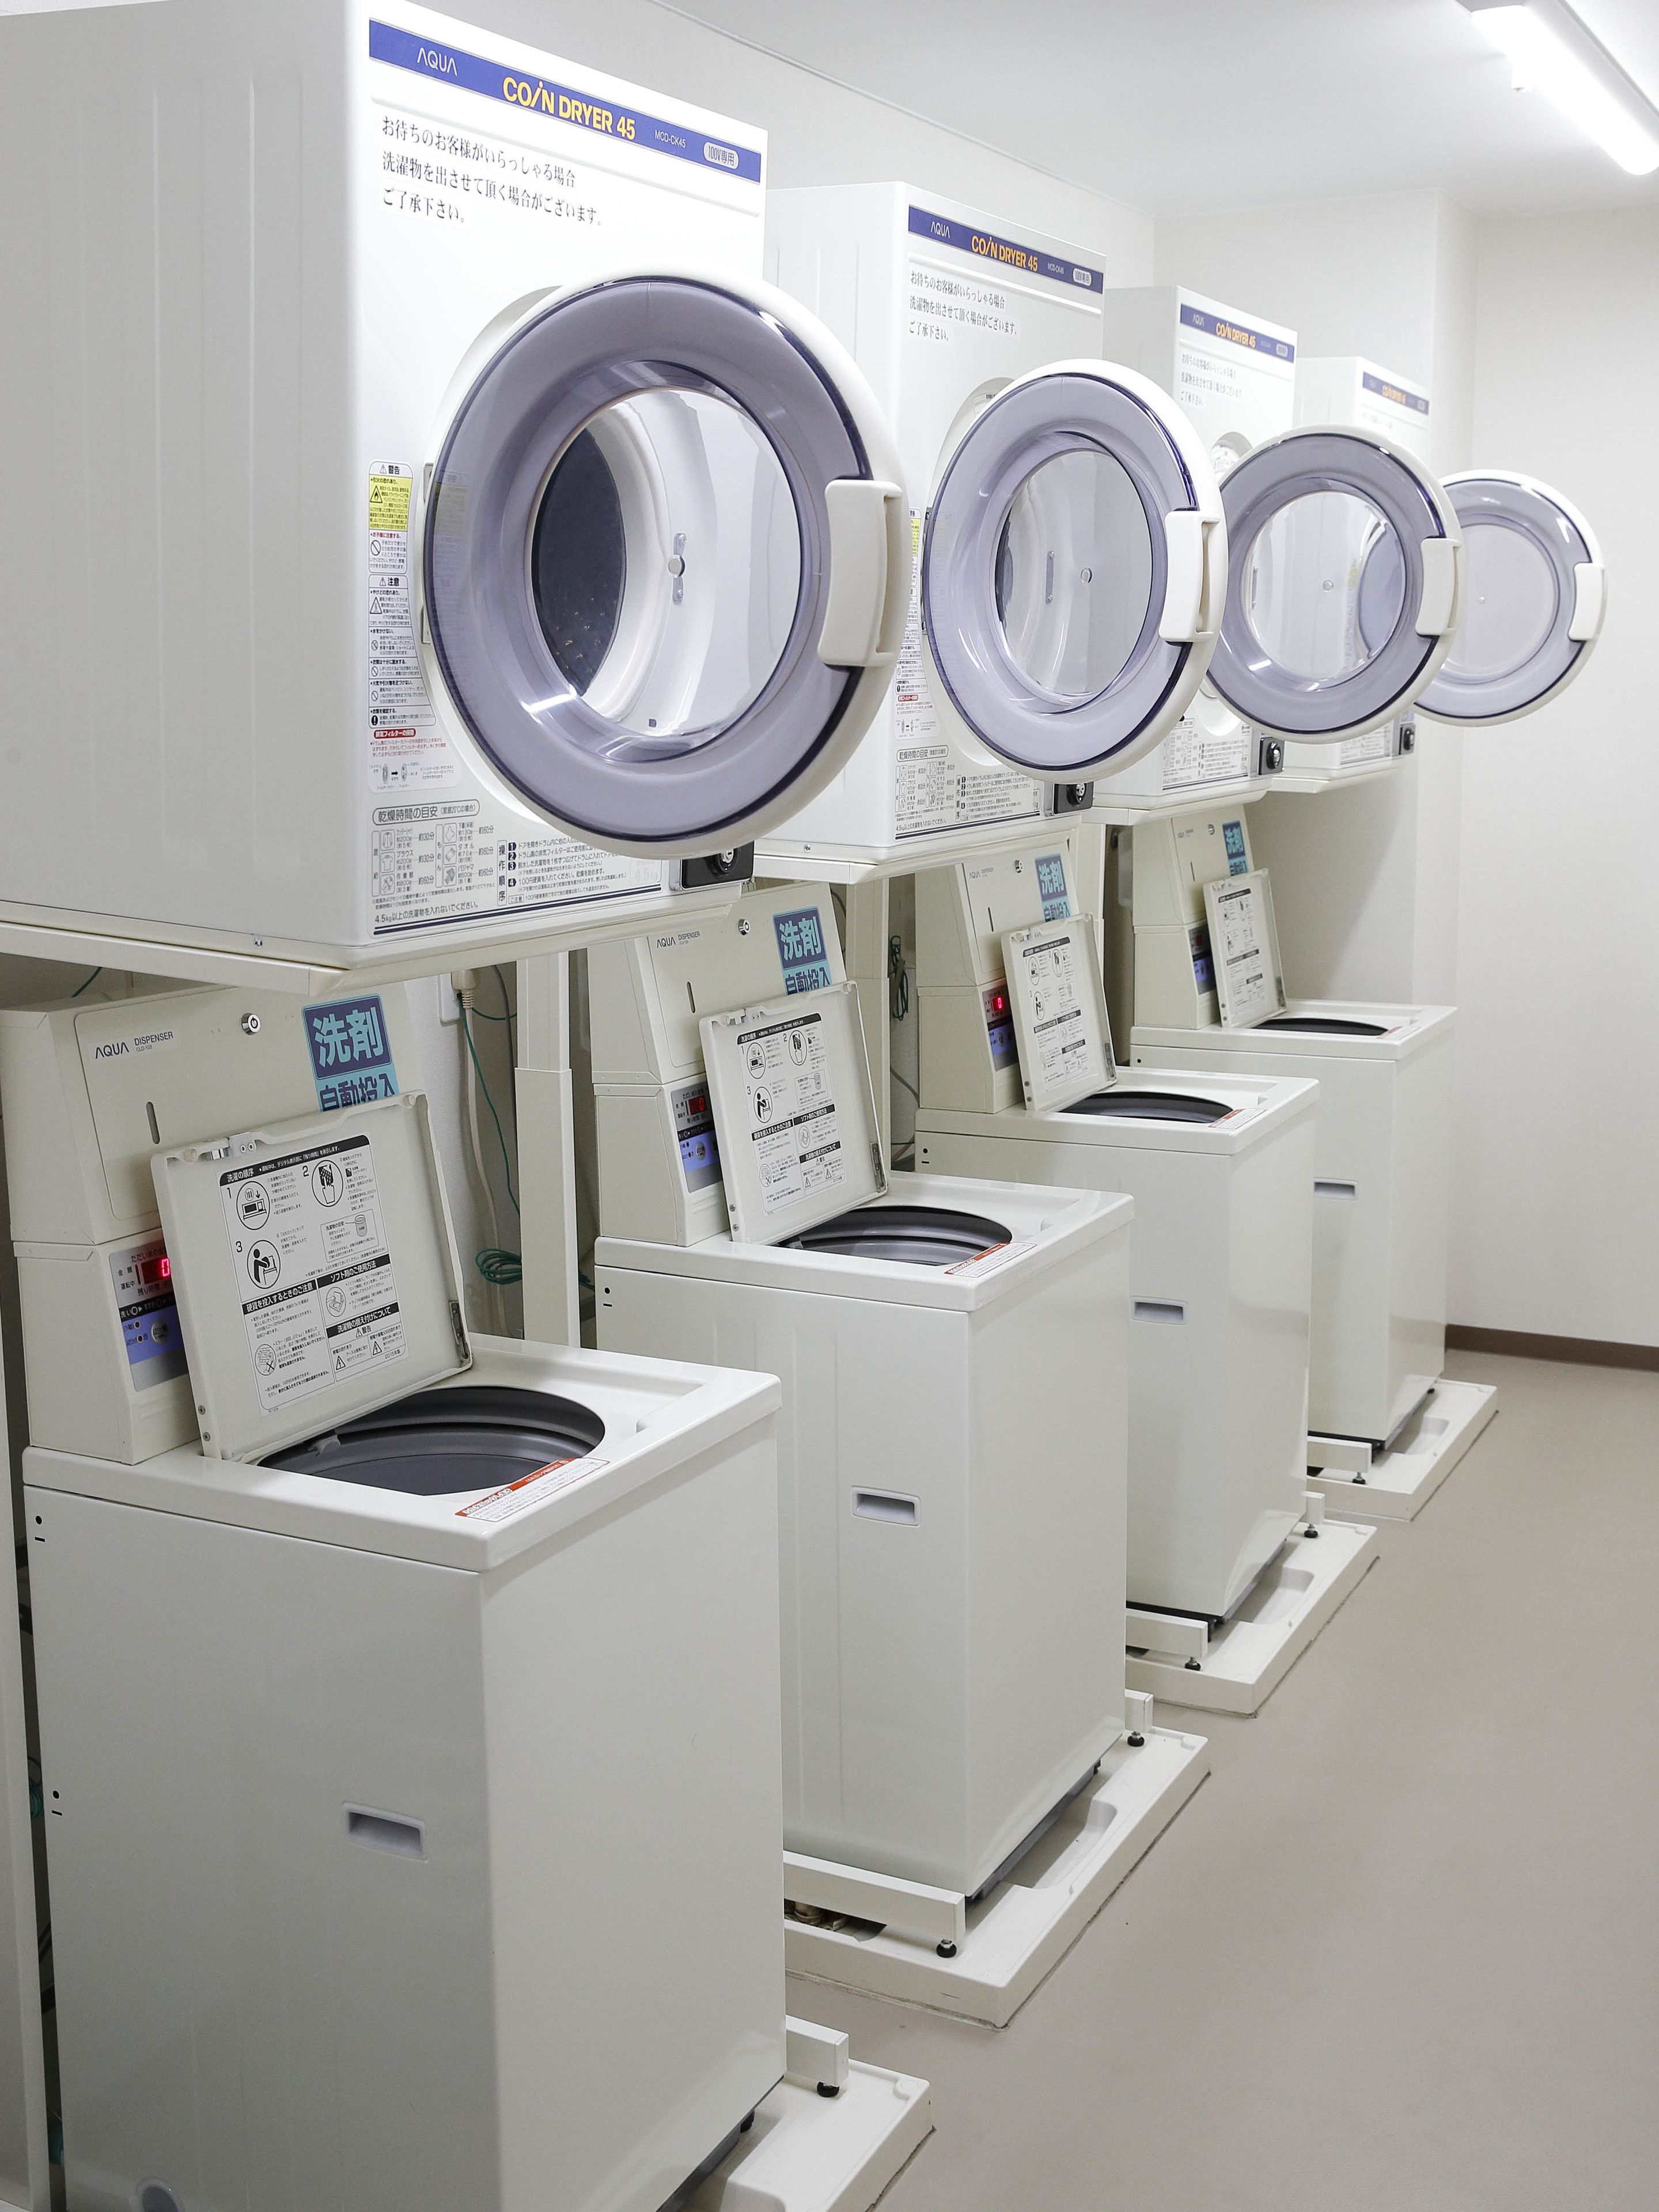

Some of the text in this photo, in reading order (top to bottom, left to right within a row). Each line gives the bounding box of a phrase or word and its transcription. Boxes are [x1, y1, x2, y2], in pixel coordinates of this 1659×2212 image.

[416, 47, 459, 76] AQUA
[558, 94, 613, 134] DRYER
[616, 116, 636, 141] 45
[654, 129, 687, 149] MCD-CK45
[381, 116, 575, 188] お待ちのお客様がいらっしゃる場合
[707, 145, 736, 167] 100V専用
[381, 151, 602, 226] 洗濯物を出させて頂く場合がございます。
[382, 187, 464, 224] ご了承下さい。
[930, 221, 950, 238] AQUA
[999, 244, 1026, 268] DRYER
[1028, 256, 1037, 272] 45
[911, 271, 1005, 309] お待ちのお客様がいらっしゃる場合
[910, 296, 1017, 336] 洗濯物を出させて頂く場合がございます。
[909, 321, 949, 341] ご了承下さい。
[389, 465, 400, 475] 警告
[378, 806, 438, 823] 乾燥時間の目安
[1039, 861, 1065, 895] 洗剤
[657, 937, 676, 948] AQUA
[678, 931, 700, 940] DISPENSER
[779, 916, 822, 961] 洗剤
[785, 967, 830, 995] 自動投入
[96, 1031, 173, 1059] AQUA DISPENSER
[314, 1006, 384, 1067] 洗剤
[783, 1033, 787, 1042] 2
[741, 1046, 744, 1054] 1
[320, 1073, 396, 1112] 自動投入
[747, 1086, 751, 1094] 3
[226, 1168, 254, 1182] 洗濯の順序
[302, 1165, 309, 1177] 2
[226, 1187, 232, 1198] 1
[236, 1241, 243, 1253] 3
[162, 1258, 171, 1277] 0
[247, 1282, 314, 1312] 硬貨を投入するときのご注意
